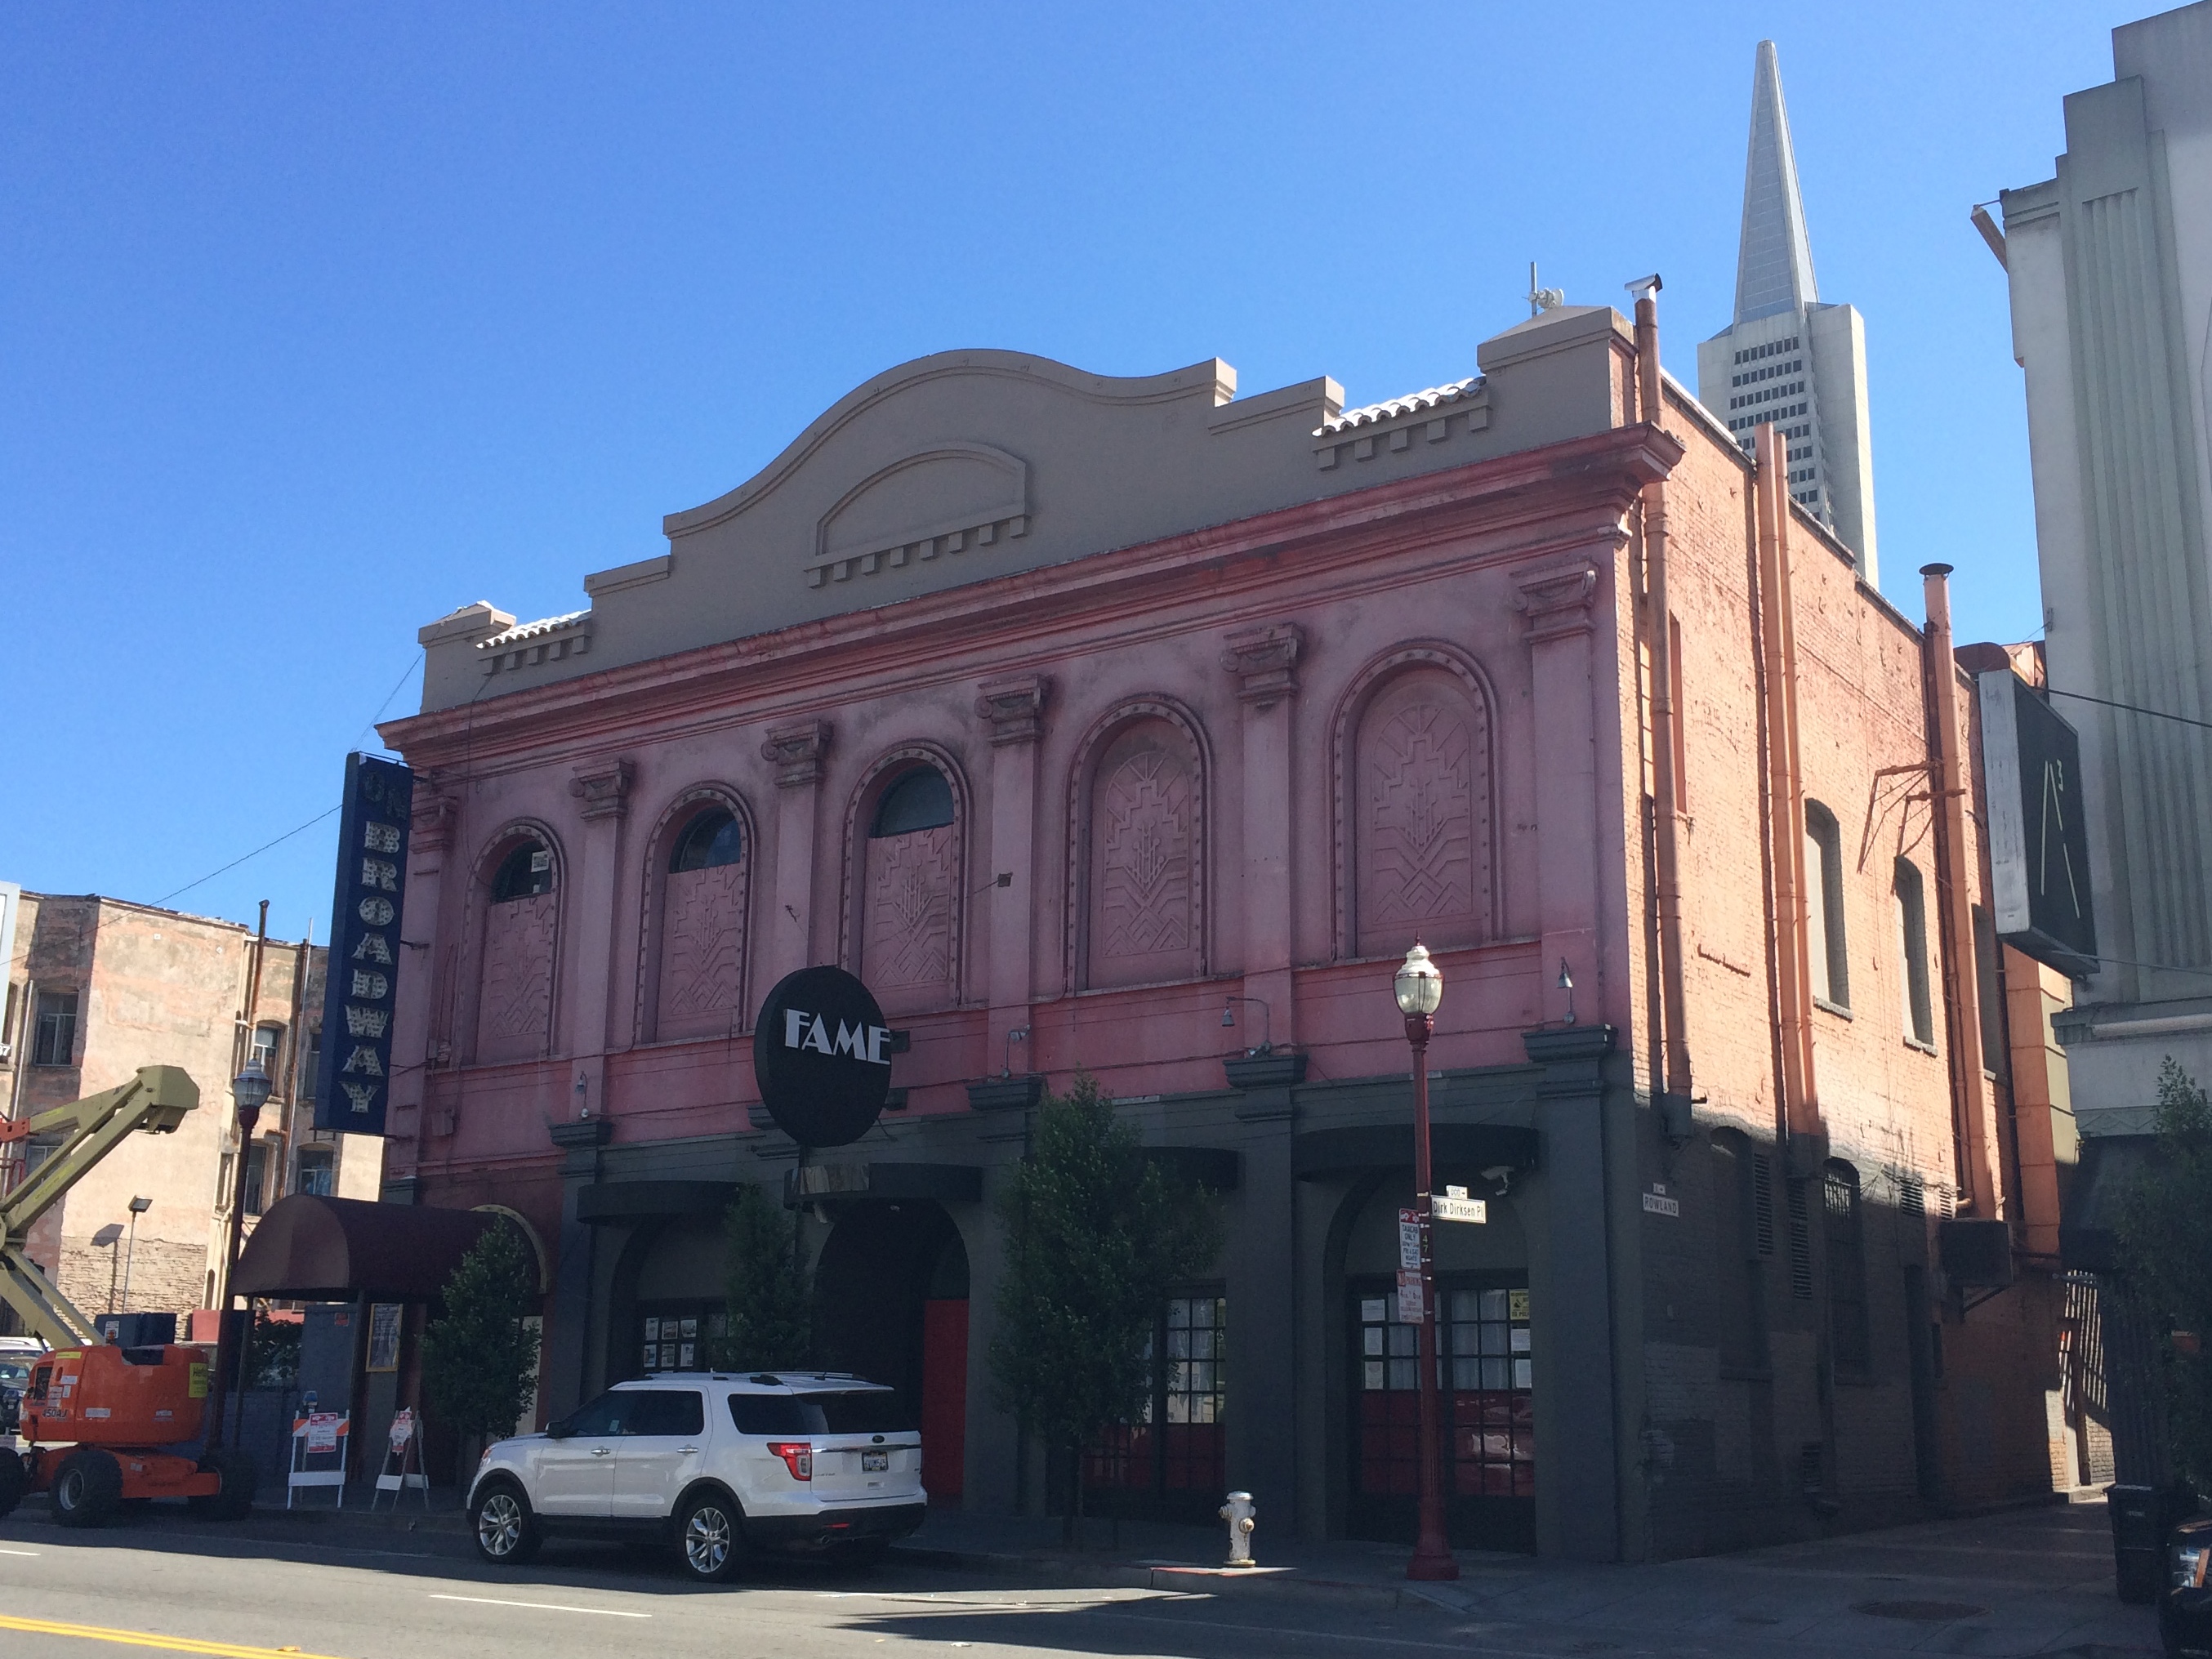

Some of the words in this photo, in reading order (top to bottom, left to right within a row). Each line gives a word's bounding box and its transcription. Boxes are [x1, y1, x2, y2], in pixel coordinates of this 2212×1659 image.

[337, 820, 400, 1114] BROADWAY
[783, 1008, 890, 1065] FAME
[1434, 1200, 1447, 1214] Dirk
[1450, 1202, 1475, 1217] Dirksen
[1477, 1206, 1483, 1218] Pl
[1644, 1196, 1676, 1213] ROWLAND
[1404, 1233, 1416, 1241] ONLY
[42, 1408, 69, 1418] 450AJ
